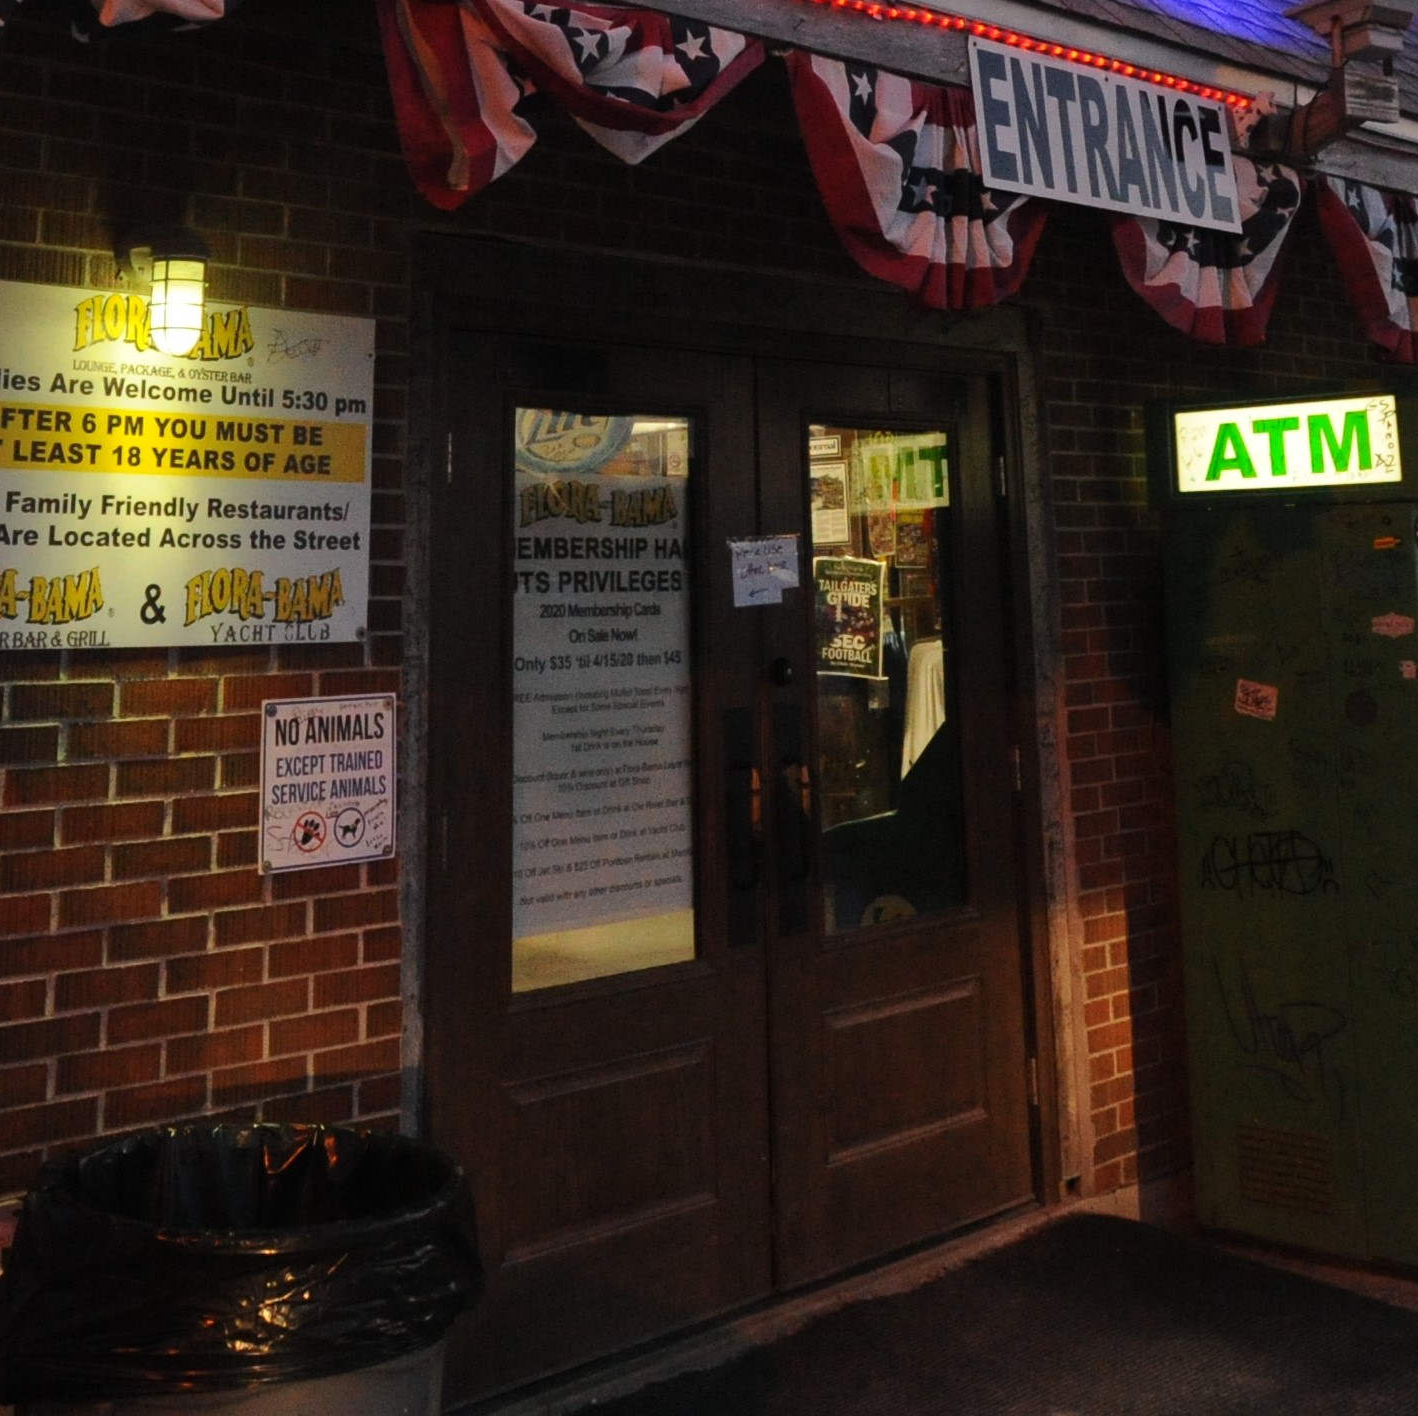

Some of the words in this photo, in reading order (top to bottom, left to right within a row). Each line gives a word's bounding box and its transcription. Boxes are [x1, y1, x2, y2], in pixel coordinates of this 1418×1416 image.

[976, 48, 1235, 224] ENTRANCE
[72, 359, 117, 374] LOUNGE,
[120, 363, 175, 380] PACKAGE,
[178, 368, 186, 379] &
[189, 369, 230, 382] OYSTER
[231, 372, 253, 385] BAR
[49, 372, 94, 395] Are
[103, 376, 212, 403] Welcome
[221, 385, 274, 408] Until
[282, 389, 328, 411] 5:30
[334, 398, 366, 416] pm
[82, 413, 96, 433] 6
[107, 415, 143, 436] PM
[154, 417, 206, 440] YOU
[216, 421, 284, 444] MUST
[293, 425, 323, 446] BE
[12, 440, 101, 465] LEAST
[112, 445, 141, 467] 18
[152, 447, 236, 471] YEARS
[244, 452, 275, 473] OF
[283, 454, 331, 475] AGE
[1204, 410, 1373, 482] ATM
[5, 491, 92, 520] Family
[101, 495, 199, 522] Friendly
[207, 498, 349, 522] Restaurants/
[519, 480, 679, 528] FLORA-BAMA
[48, 525, 151, 548] Located
[159, 528, 242, 549] Across
[250, 529, 286, 550] the
[293, 530, 361, 551] Street
[517, 537, 648, 560] EMBERSHIP
[654, 537, 683, 560] HA
[558, 570, 682, 593] PRIVILEGES
[140, 583, 167, 625] &
[183, 567, 346, 627] FLORA-BAMA
[539, 603, 566, 619] 2020
[567, 602, 633, 619] Membership
[634, 602, 661, 616] Cards
[12, 631, 47, 649] BAR
[50, 631, 62, 647] &
[66, 631, 110, 647] GRILL
[210, 623, 277, 642] YACHT
[284, 623, 331, 641] CLUB
[569, 629, 586, 644] On
[587, 628, 609, 643] Sale
[610, 627, 638, 642] Now!
[829, 633, 867, 650] SEC
[514, 656, 546, 674] Only
[550, 655, 572, 671] $35
[593, 652, 634, 668] 4/15/20
[637, 651, 661, 666] then
[663, 650, 682, 665] $45
[821, 647, 873, 664] FOOTBALL
[275, 717, 300, 747] NO
[304, 712, 384, 745] ANIMALS
[276, 754, 326, 778] EXCEPT
[329, 749, 383, 773] TRAINED
[271, 780, 326, 805] SERVICE
[330, 774, 387, 799] ANIMALS
